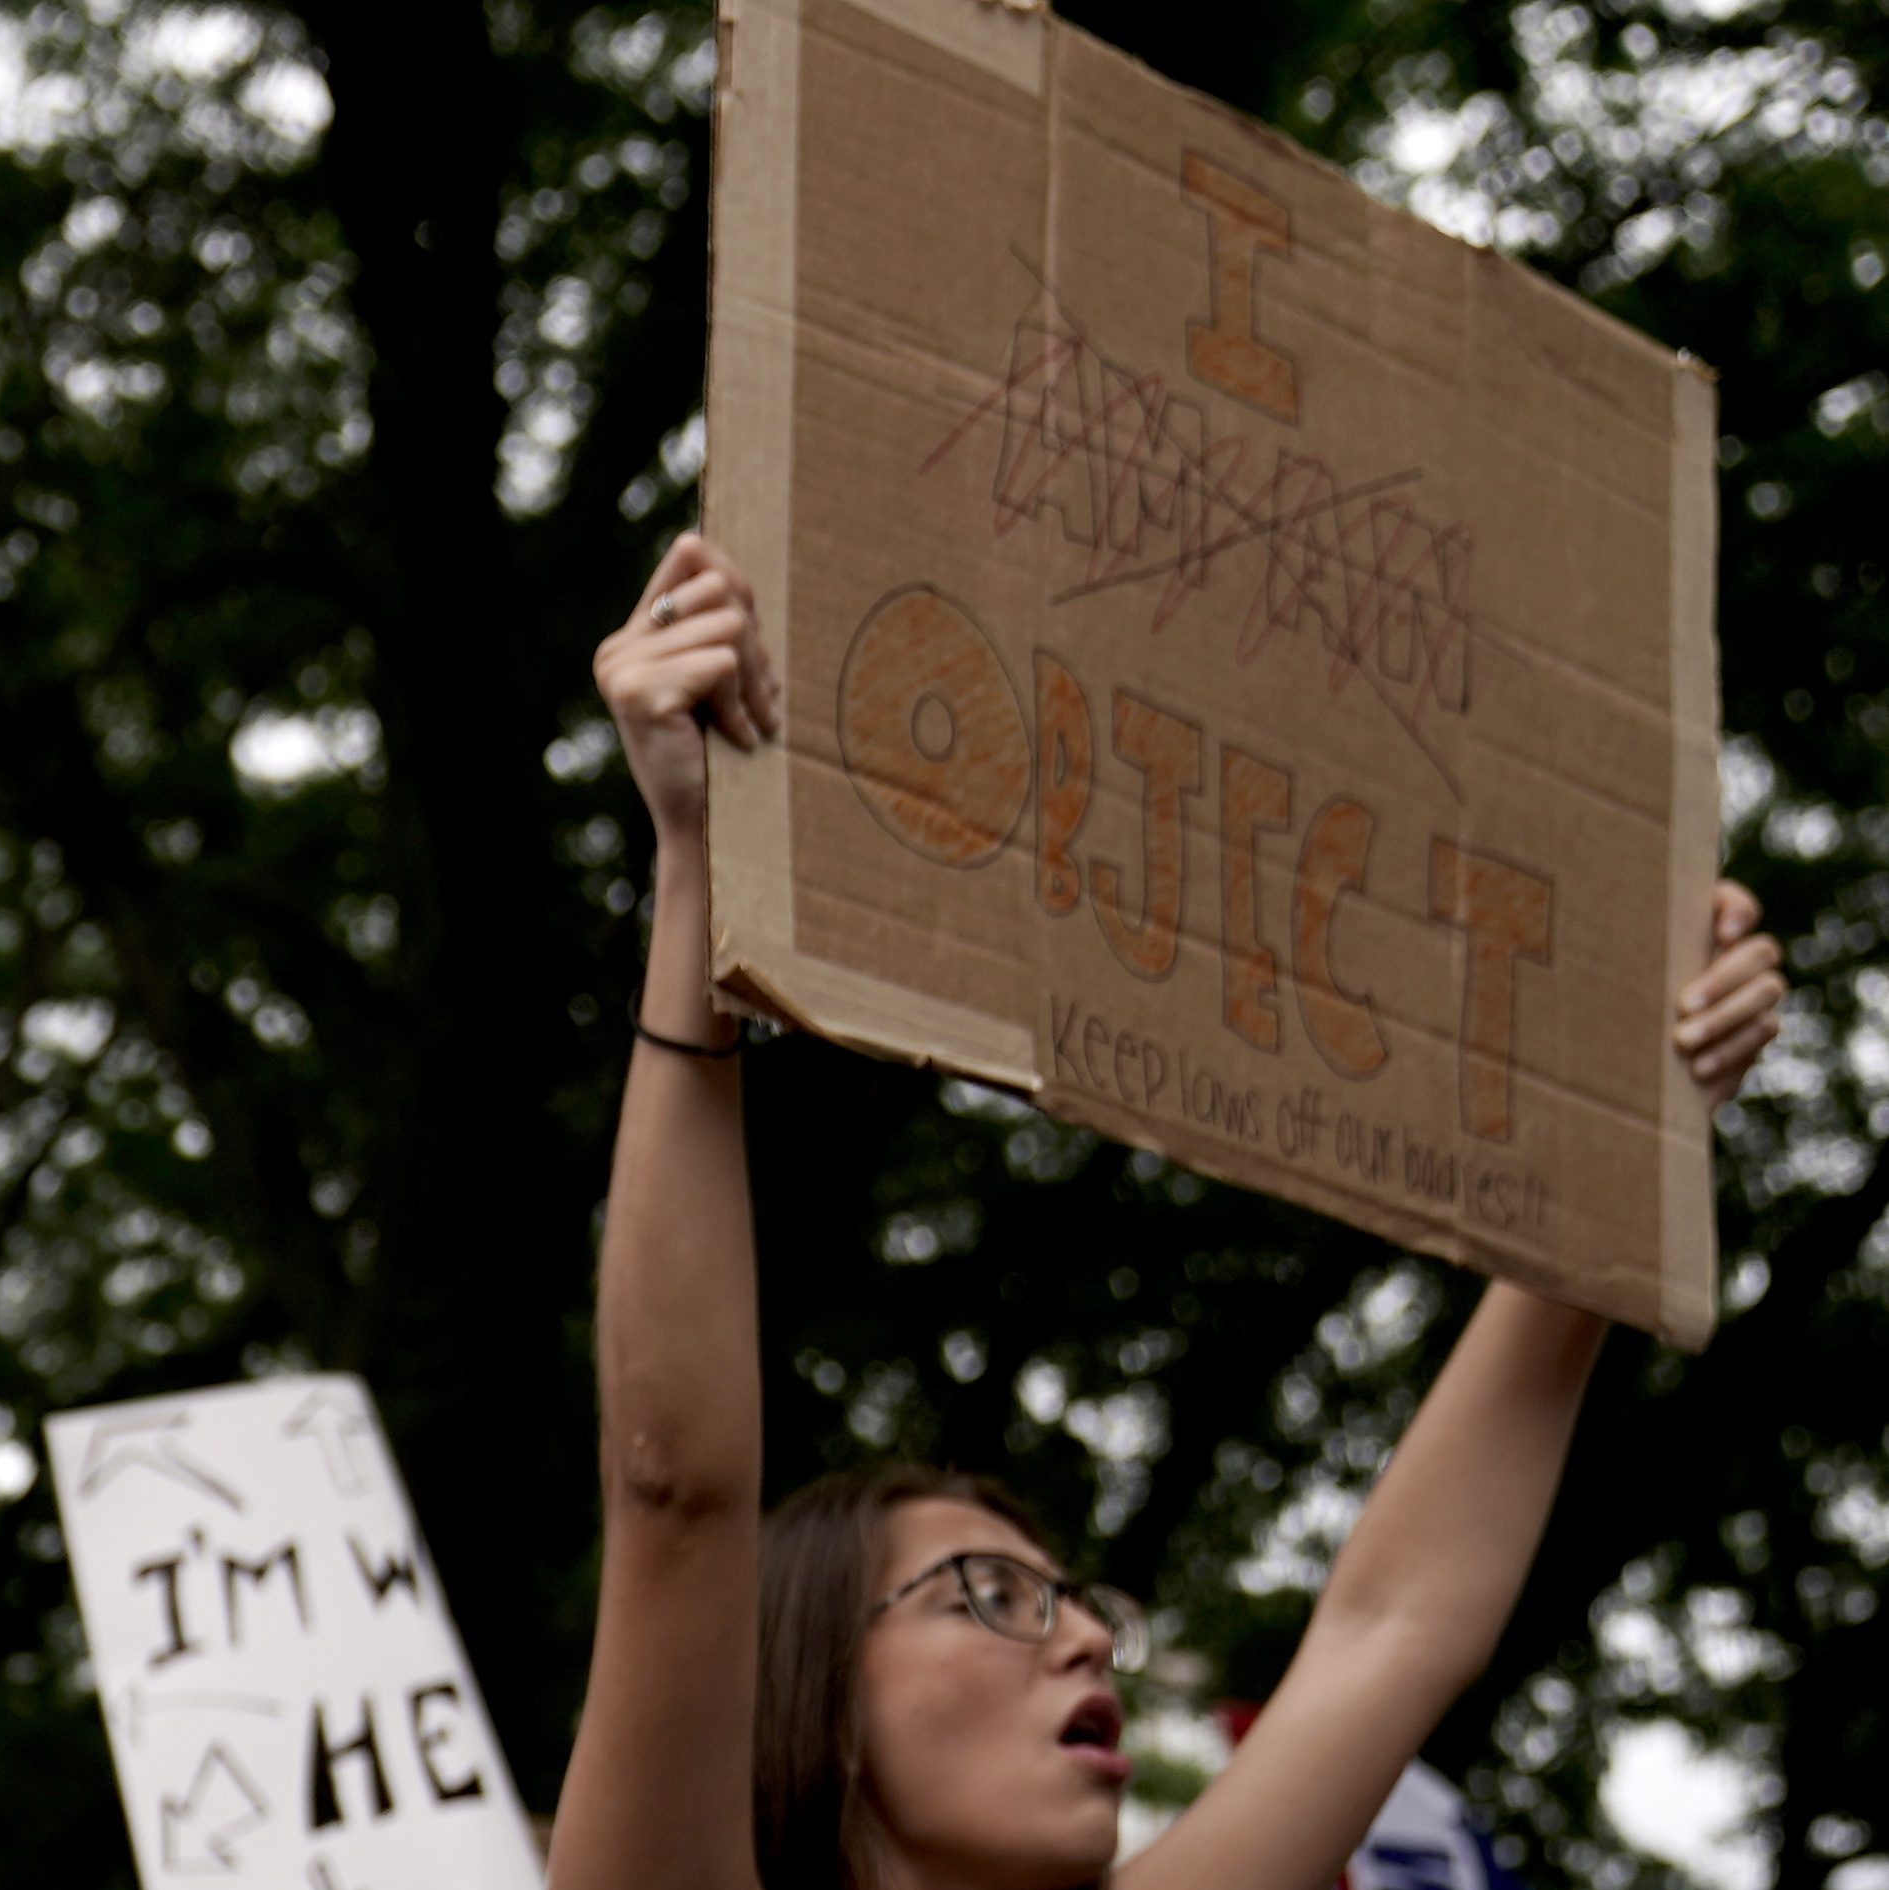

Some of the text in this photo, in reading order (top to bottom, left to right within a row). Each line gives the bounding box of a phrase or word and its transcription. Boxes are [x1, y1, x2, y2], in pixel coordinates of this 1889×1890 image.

[1181, 148, 1300, 427] I
[838, 580, 1553, 1144] OBJECT
[1051, 994, 1168, 1109] Keep
[1179, 1049, 1262, 1144] laws
[1276, 1087, 1330, 1159] off
[1335, 1112, 1394, 1183] our
[132, 1525, 312, 1672] I'M
